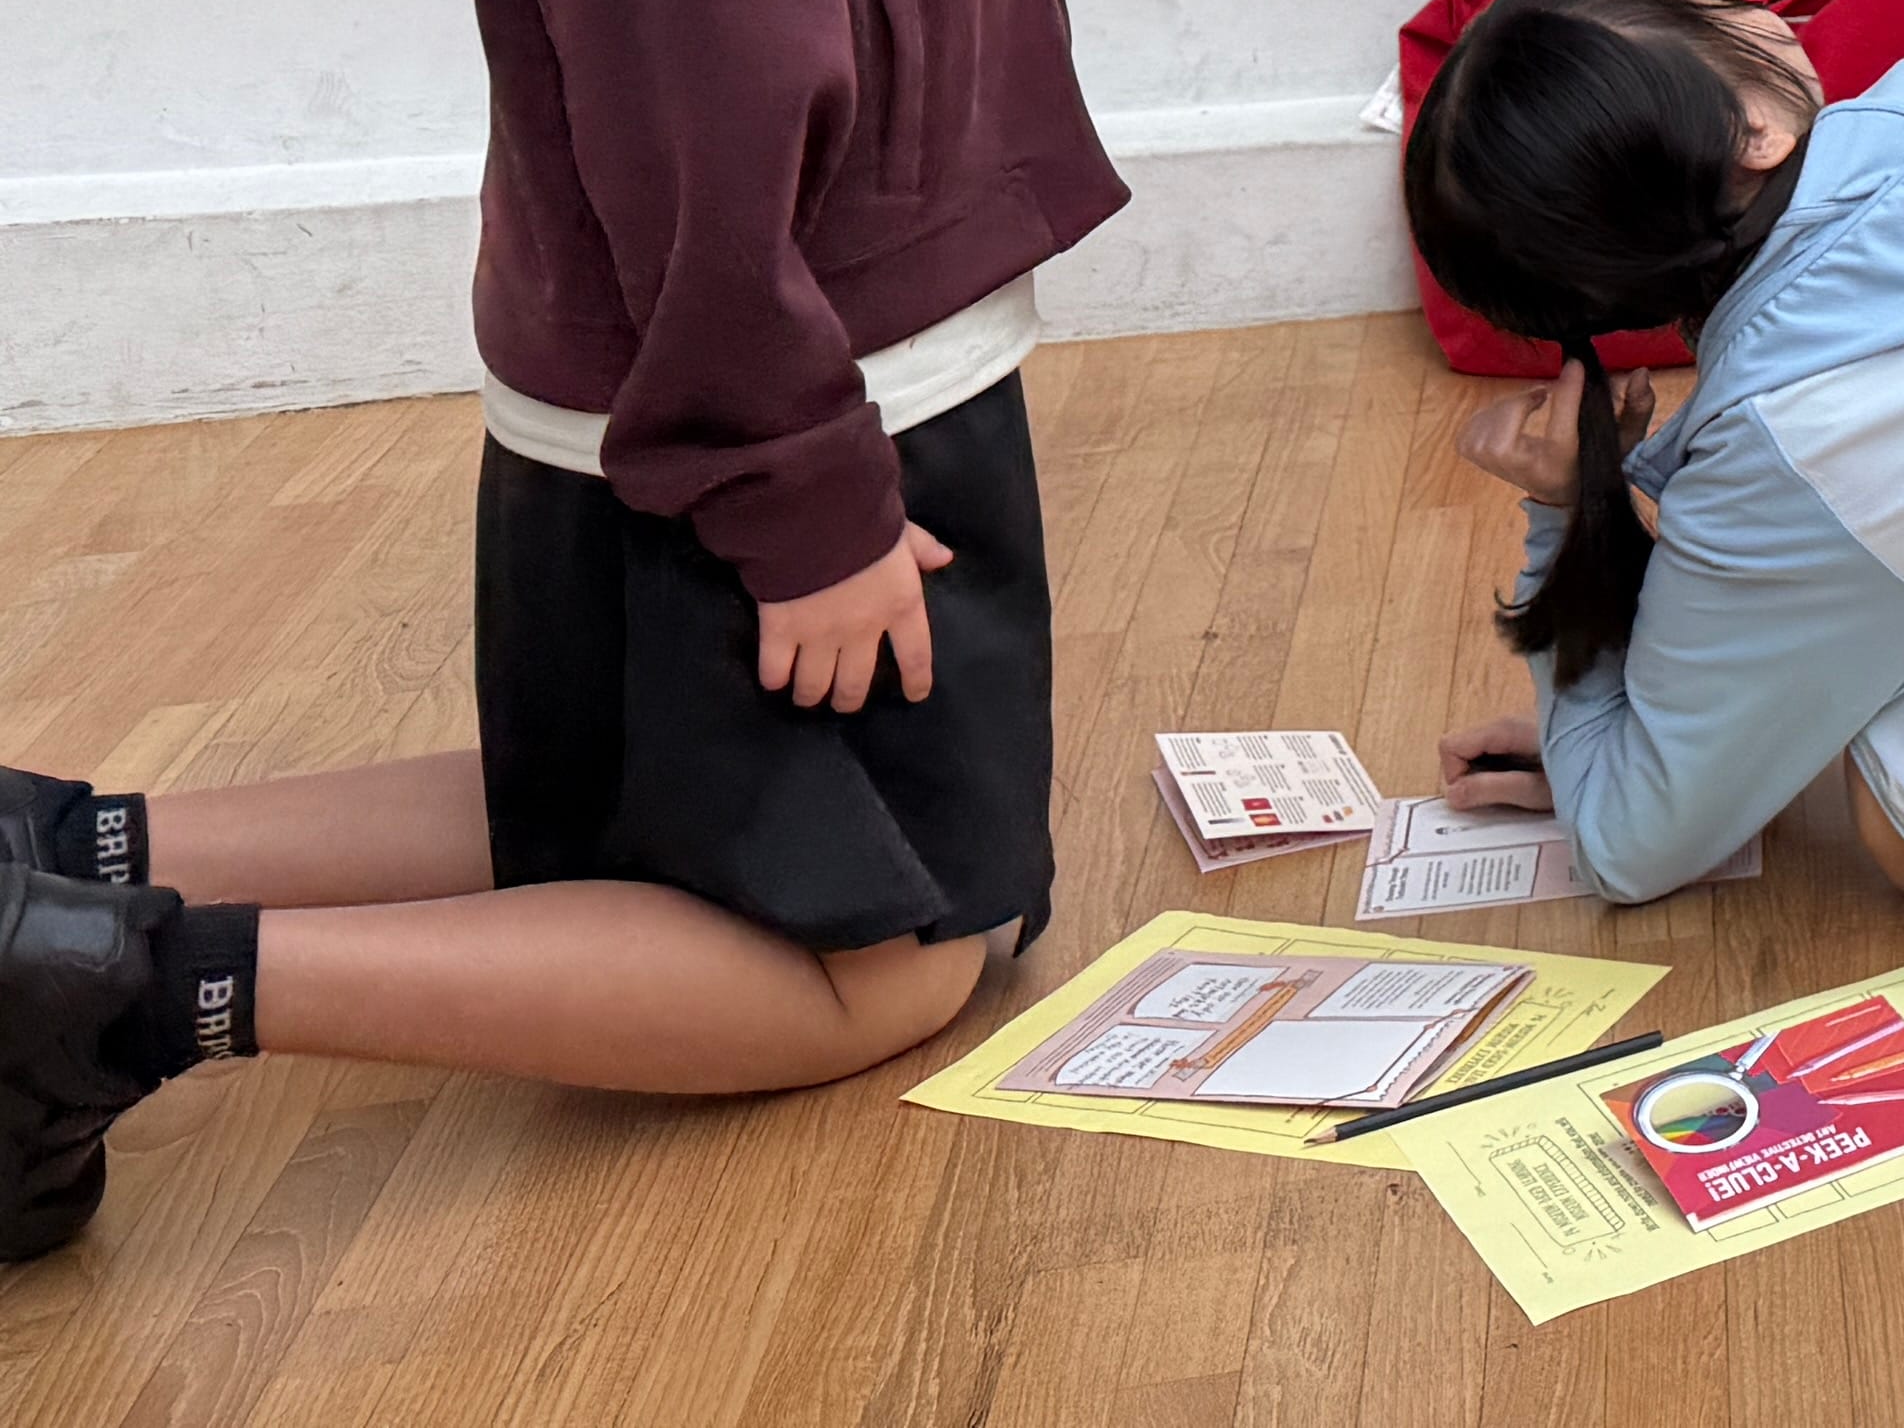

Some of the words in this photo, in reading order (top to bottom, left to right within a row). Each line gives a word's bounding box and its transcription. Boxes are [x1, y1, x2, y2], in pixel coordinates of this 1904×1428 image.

[96, 808, 130, 884] BRP
[1761, 1133, 1817, 1158] DETECTIVE
[1816, 1124, 1838, 1139] ART
[1697, 1152, 1762, 1182] VIEWFINDER
[1704, 1126, 1872, 1202] PEEK-A-CLUE!
